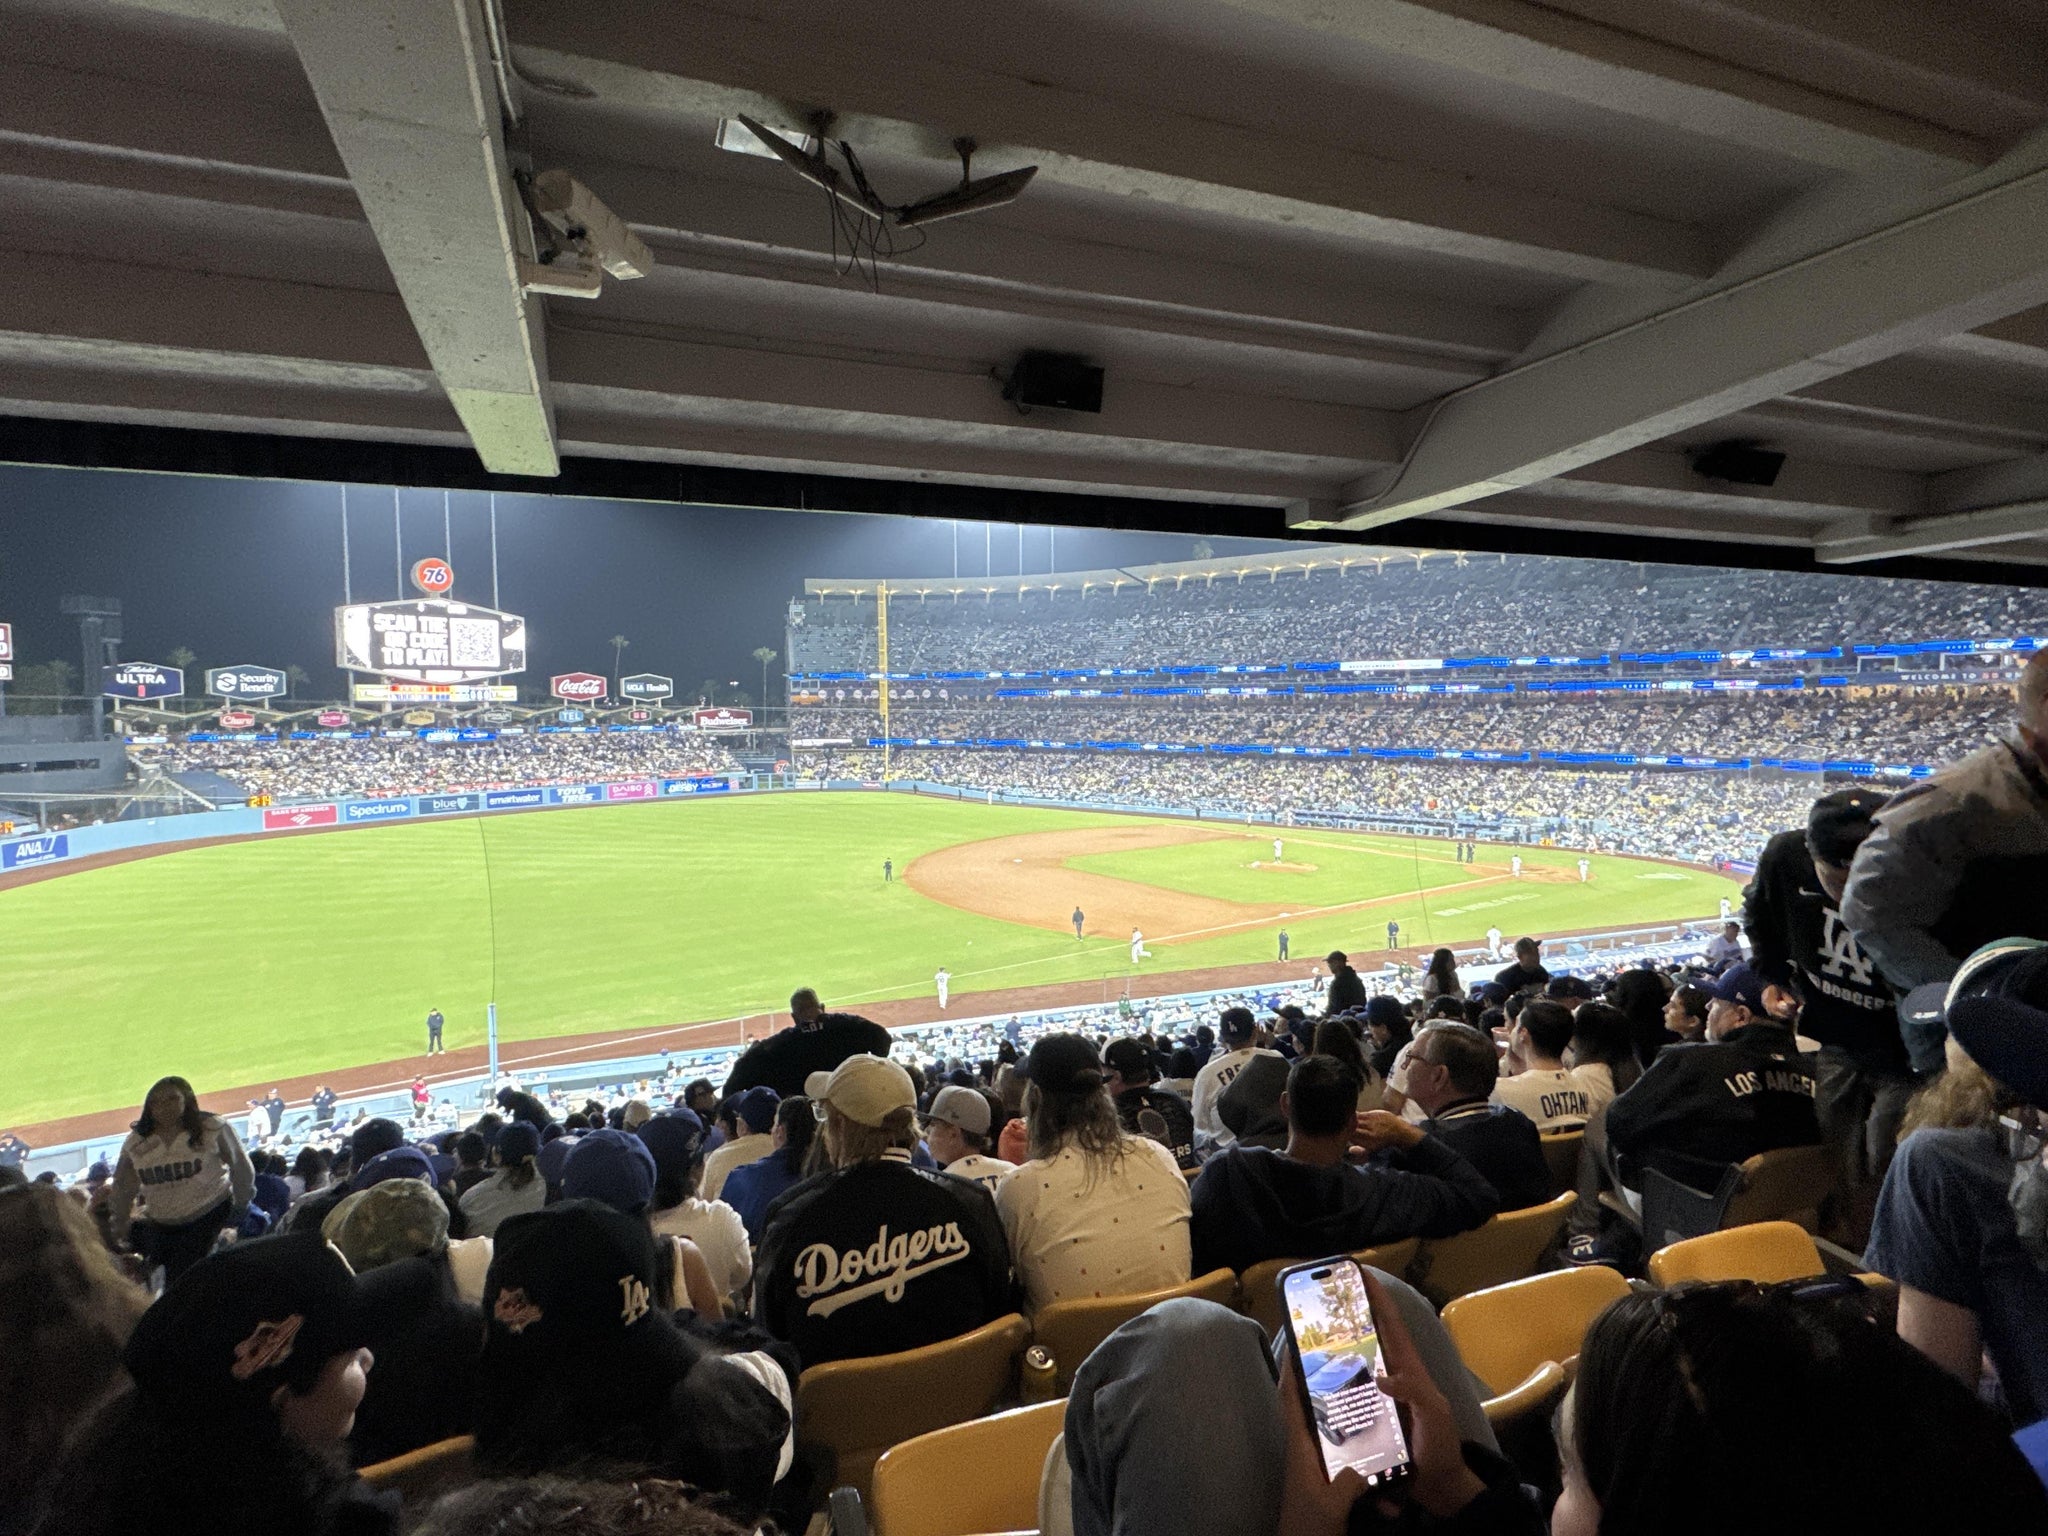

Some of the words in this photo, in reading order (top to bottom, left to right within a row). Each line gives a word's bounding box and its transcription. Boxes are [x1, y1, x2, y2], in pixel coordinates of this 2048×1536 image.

[424, 568, 447, 584] 76
[373, 613, 418, 632] SCAN
[418, 616, 448, 633] THE
[381, 647, 404, 665] TO
[116, 673, 166, 684] ULTRA
[240, 673, 279, 685] Security
[240, 684, 275, 693] Benefit
[626, 683, 644, 692] UCLA
[563, 711, 580, 721] TEL
[700, 716, 748, 726] Budweiser
[557, 787, 587, 795] TOYO
[612, 785, 642, 793] DAISO
[489, 794, 540, 805] smartwater
[562, 793, 595, 802] TIRES
[433, 799, 457, 808] blue
[350, 803, 401, 818] Spectrum
[16, 841, 43, 858] ANA
[1724, 1071, 1763, 1097] LOS
[794, 1221, 970, 1303] Dodgers
[618, 1274, 650, 1326] LA
